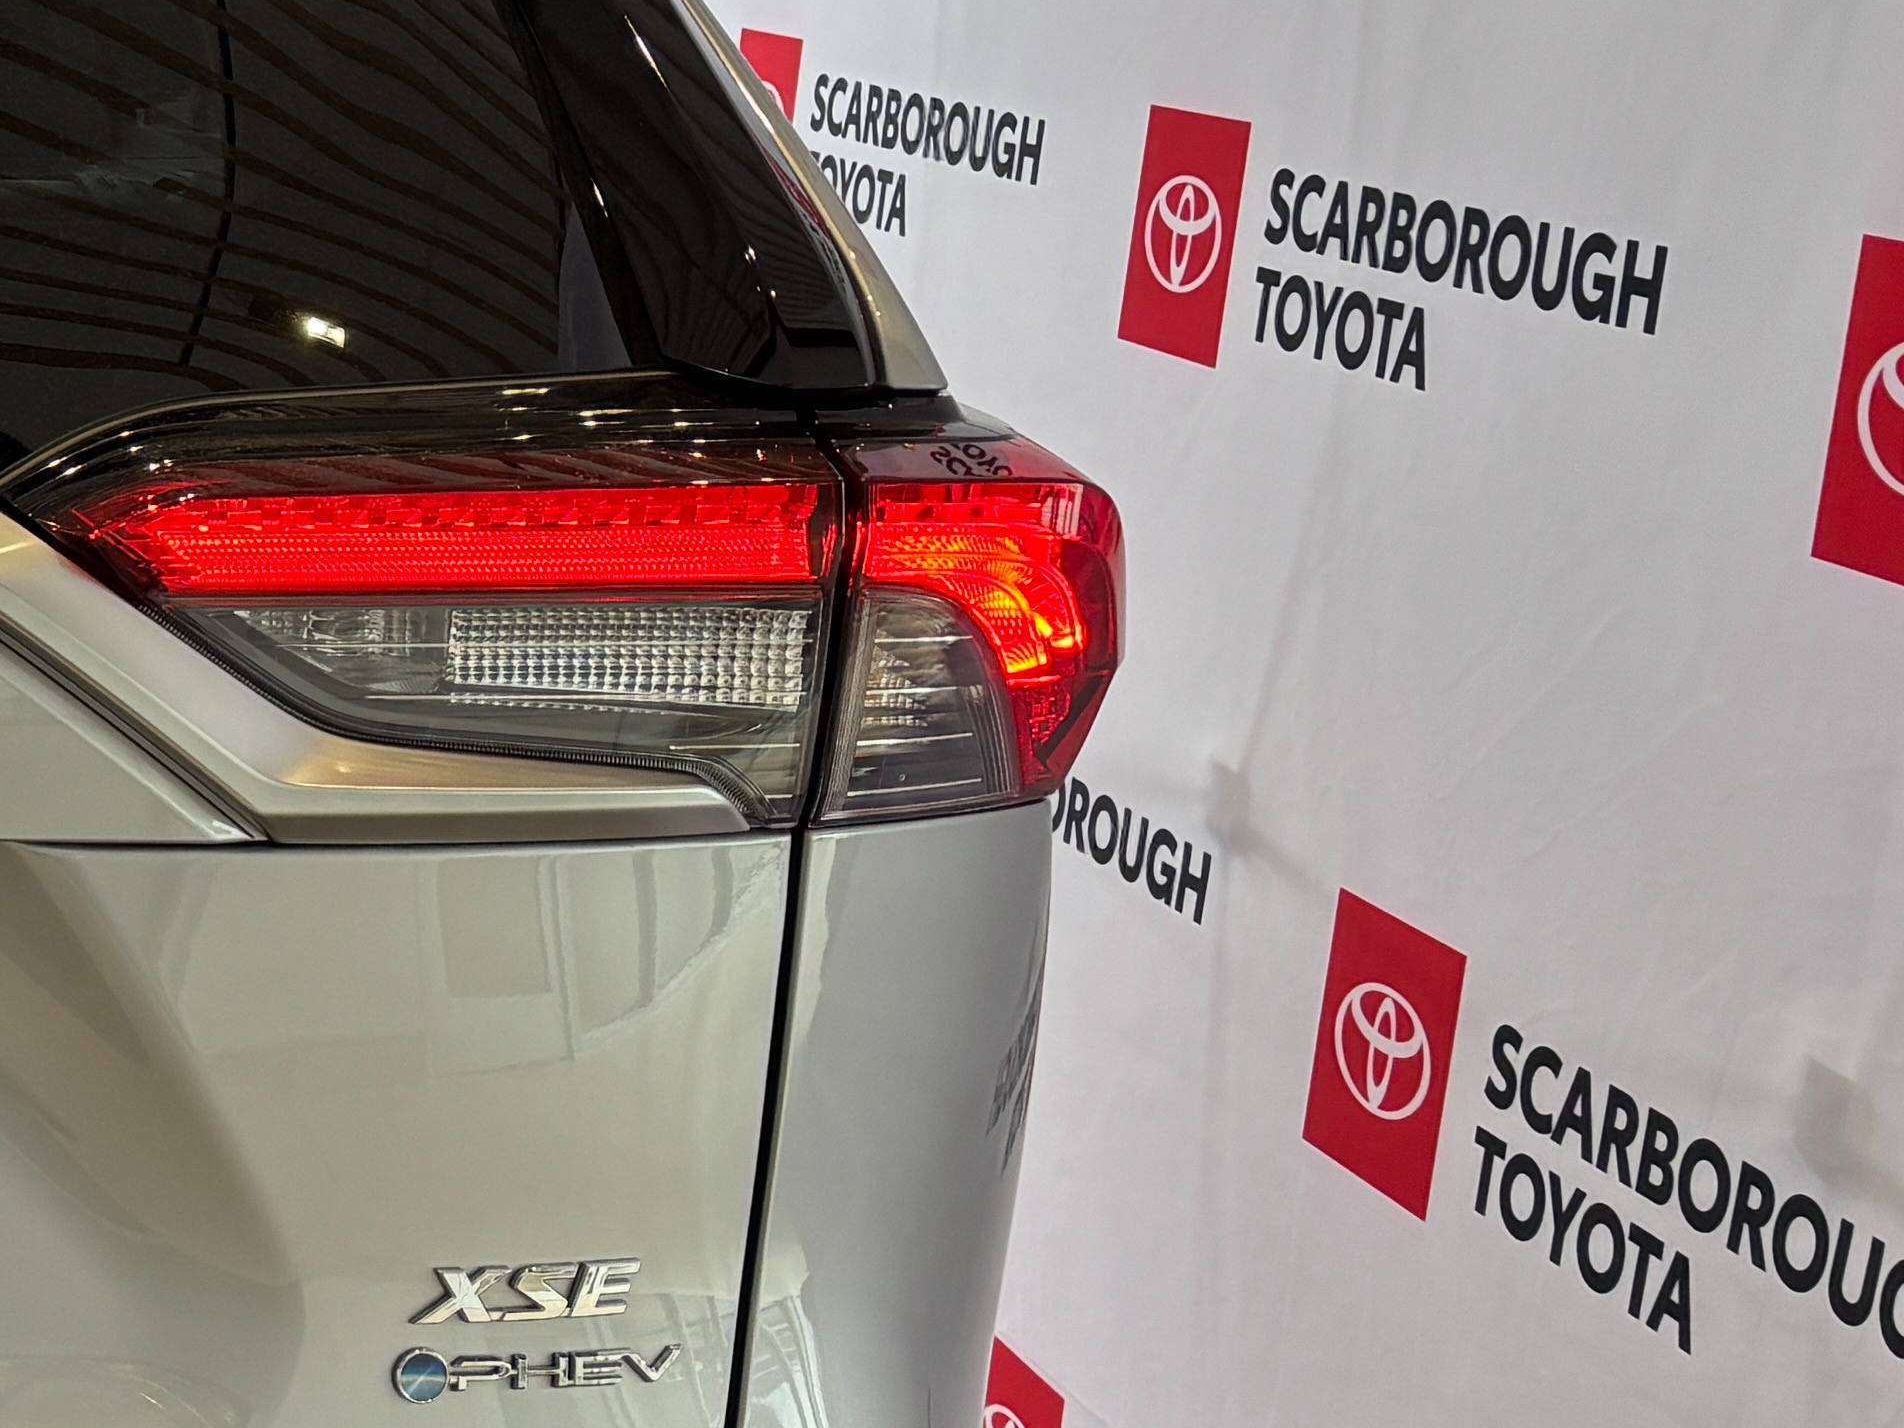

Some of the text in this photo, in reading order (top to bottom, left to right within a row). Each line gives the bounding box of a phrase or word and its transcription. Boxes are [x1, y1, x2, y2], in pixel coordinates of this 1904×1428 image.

[810, 73, 1046, 186] SCARBOROUGH
[809, 150, 906, 237] OYOTA
[1263, 167, 1669, 336] SCARBOROUGH
[1254, 266, 1426, 392] TOYOTA
[408, 1256, 643, 1324] XSE
[1474, 1125, 1692, 1356] TOYOTA
[449, 1342, 684, 1392] PHEV
